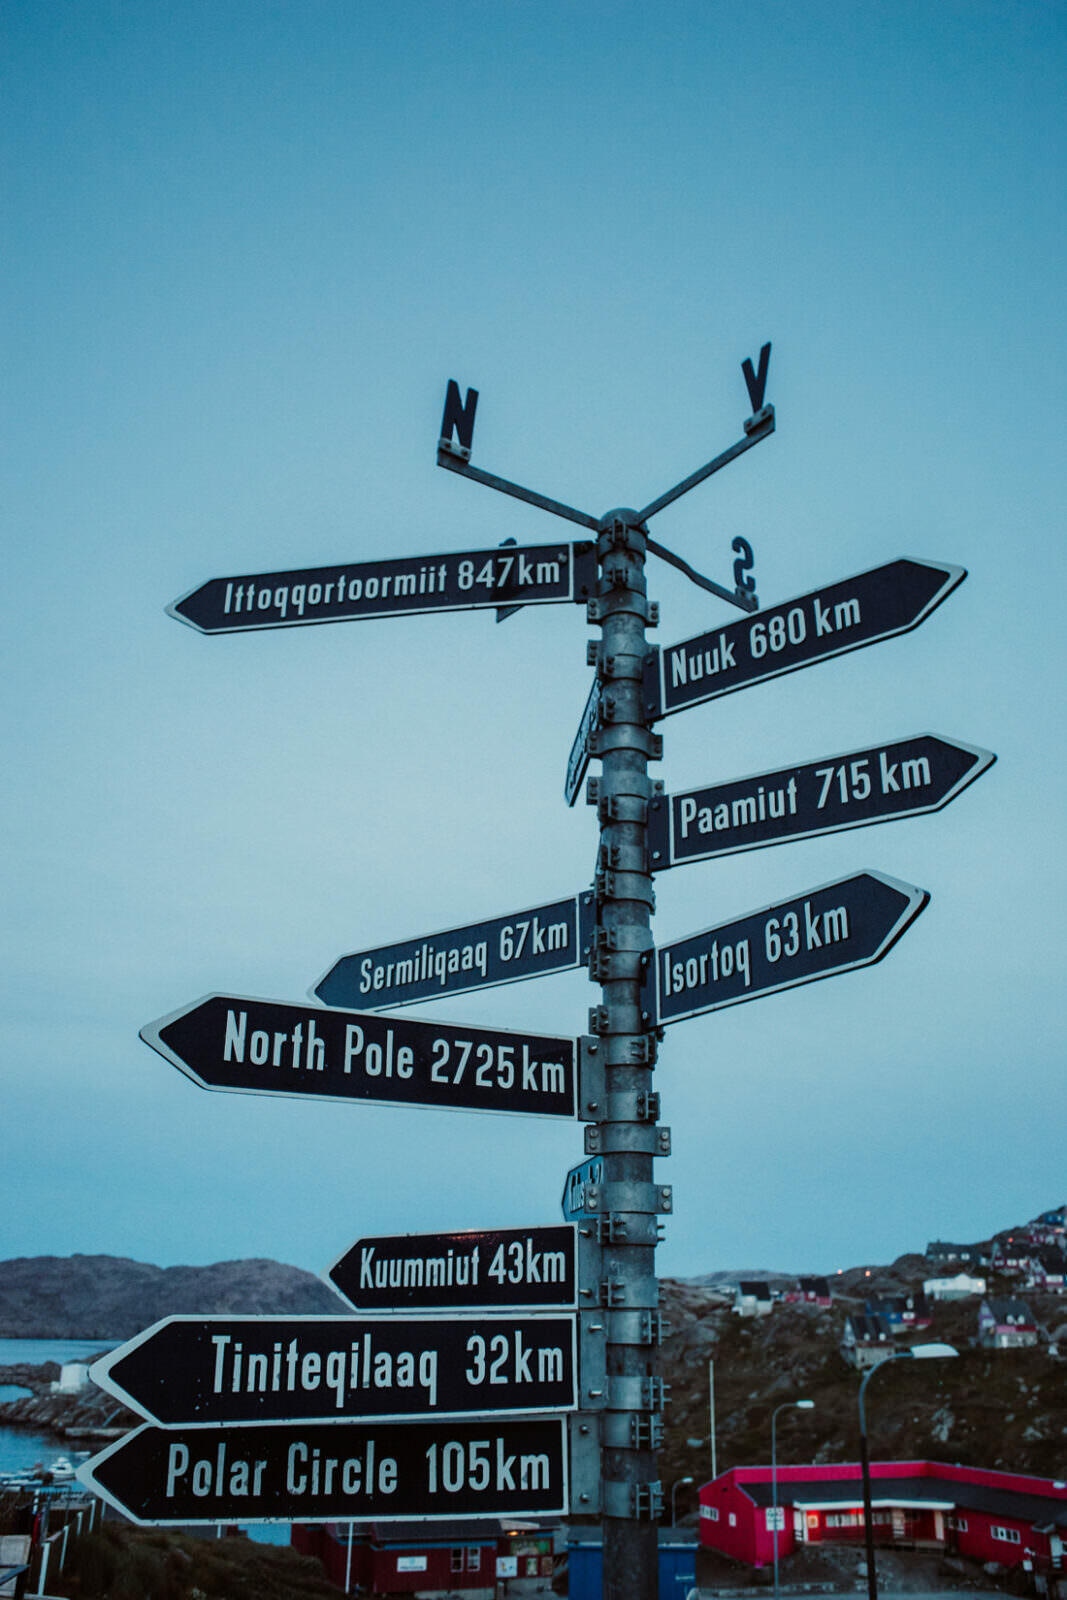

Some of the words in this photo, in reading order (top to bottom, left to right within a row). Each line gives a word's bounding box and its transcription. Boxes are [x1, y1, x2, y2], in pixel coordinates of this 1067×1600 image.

[441, 378, 479, 453] N
[222, 564, 447, 617] Ittoqqortoormiit
[671, 634, 737, 688] Nuuk
[680, 777, 798, 839] Paamiut
[359, 942, 487, 994] Sermiliqaaq
[664, 939, 750, 996] Isortoq
[223, 1010, 326, 1071] North
[343, 1024, 414, 1078] Pole
[359, 1245, 479, 1289] Kuummiut
[211, 1333, 438, 1408] Tiniteqilaaq
[166, 1442, 268, 1498] Polar
[287, 1441, 398, 1496] Circle
